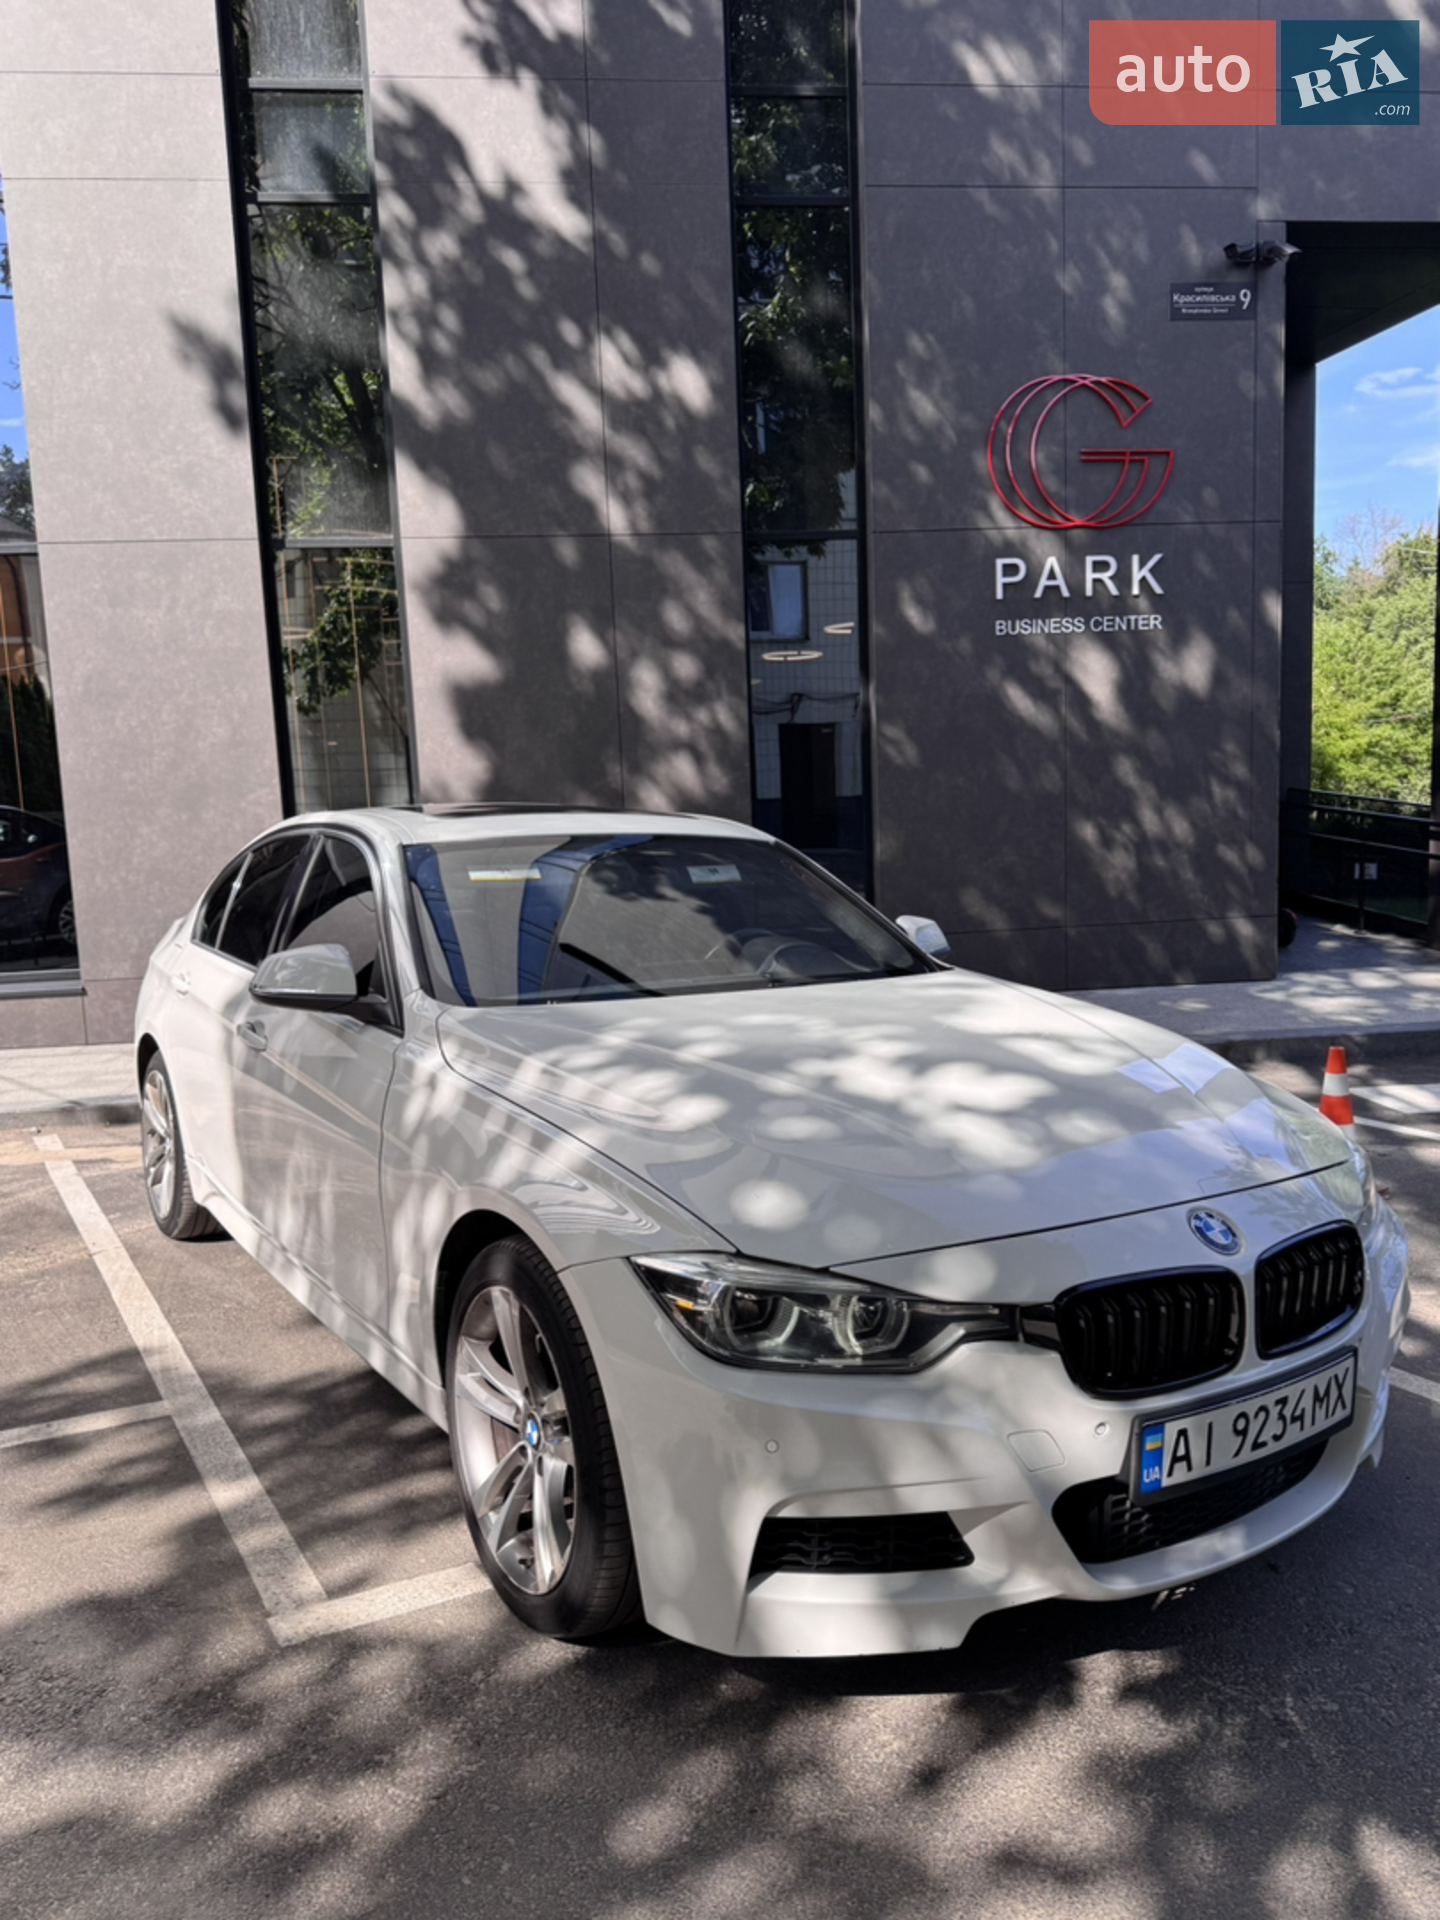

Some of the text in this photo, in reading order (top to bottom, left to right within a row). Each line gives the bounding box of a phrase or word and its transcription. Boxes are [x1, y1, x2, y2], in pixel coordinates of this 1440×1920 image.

[1239, 288, 1252, 310] 9
[994, 553, 1165, 600] PARK
[995, 614, 1163, 637] BUSINESS CENTER
[1166, 1367, 1351, 1478] AI 9234 MX
[1143, 1464, 1161, 1483] UA
